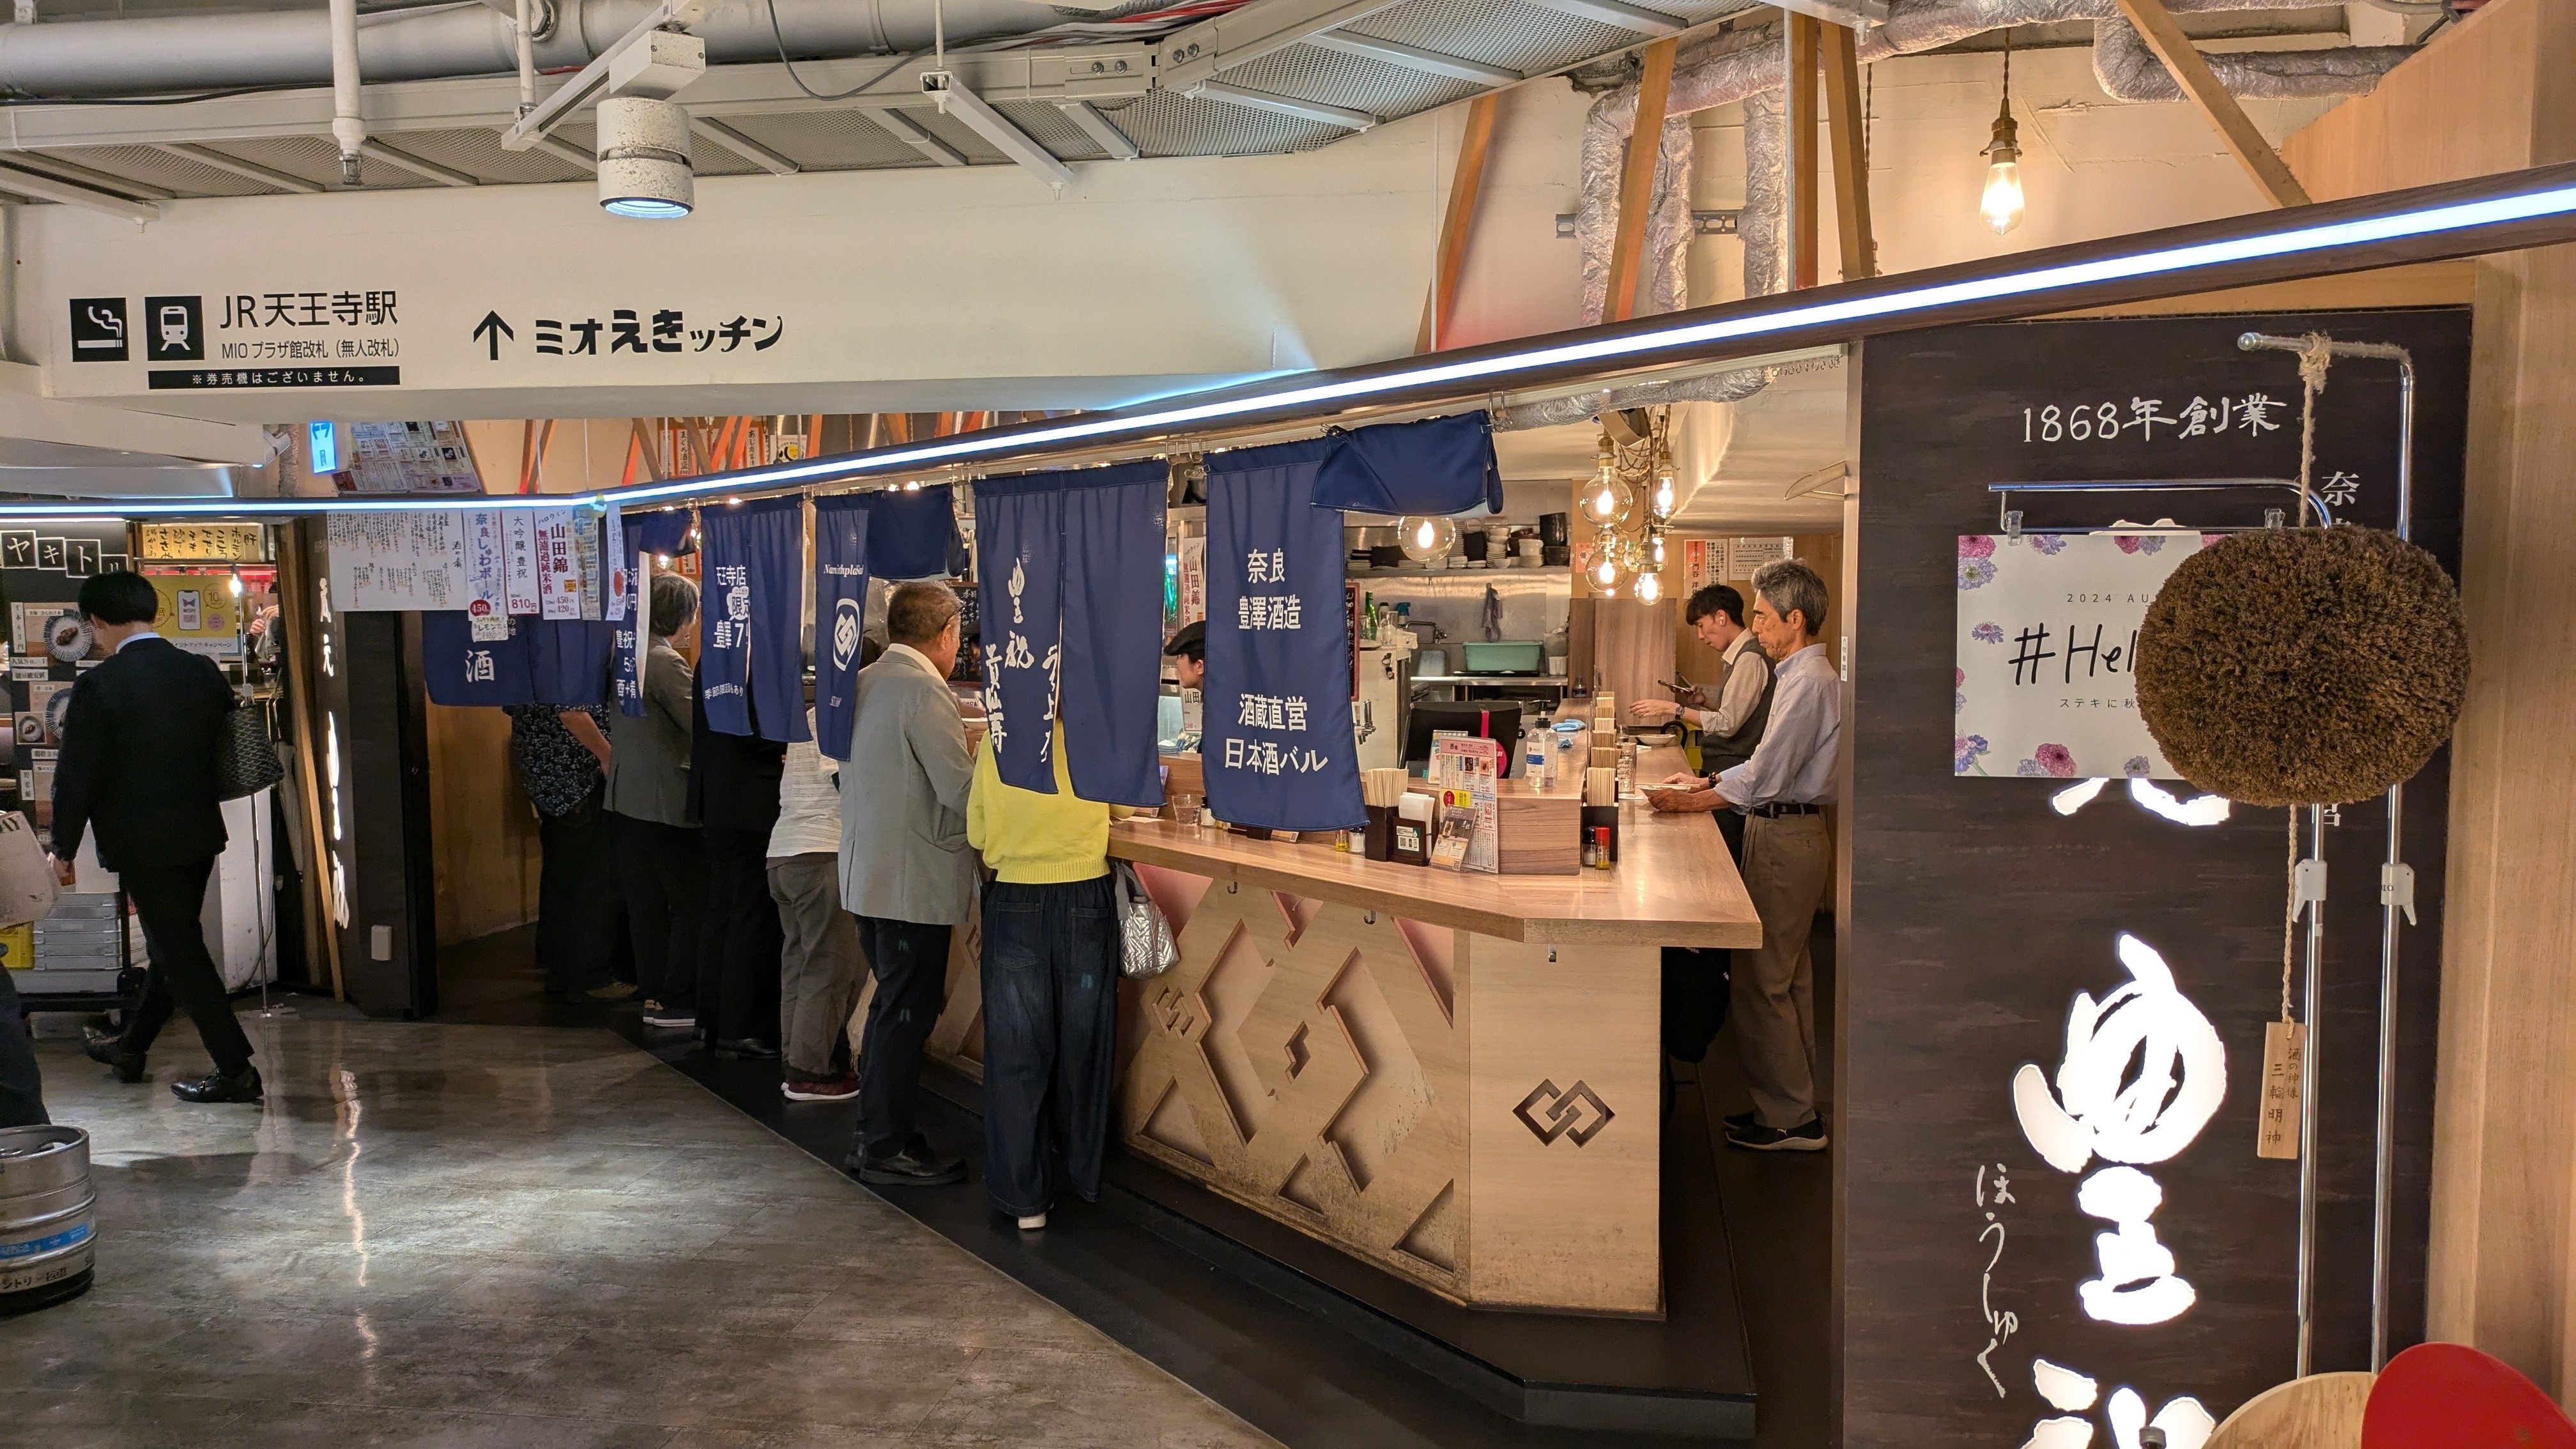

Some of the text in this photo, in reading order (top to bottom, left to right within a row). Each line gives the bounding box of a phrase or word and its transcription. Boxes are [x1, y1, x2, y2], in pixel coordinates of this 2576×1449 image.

[220, 291, 398, 329] JR天王寺駅
[222, 343, 248, 359] MIO
[535, 309, 784, 356] ミオえきッチン
[2023, 392, 2287, 442] 1868年創業
[514, 516, 526, 551] 大吟醸
[551, 523, 569, 573] 山田錦
[475, 512, 494, 600] 奈良しゅわボール
[1248, 548, 1285, 584] 奈良
[511, 599, 537, 610] 810円
[2067, 594, 2112, 602] 2024
[465, 650, 494, 683] 酒
[1184, 691, 1202, 704] 山田
[1238, 693, 1308, 732] 酒蔵直営
[1225, 738, 1328, 776] 日本酒バル
[2286, 1047, 2301, 1100] 酒の神様
[2266, 1062, 2285, 1146] 三輪明神
[1977, 1162, 2018, 1399] ほうしゅく
